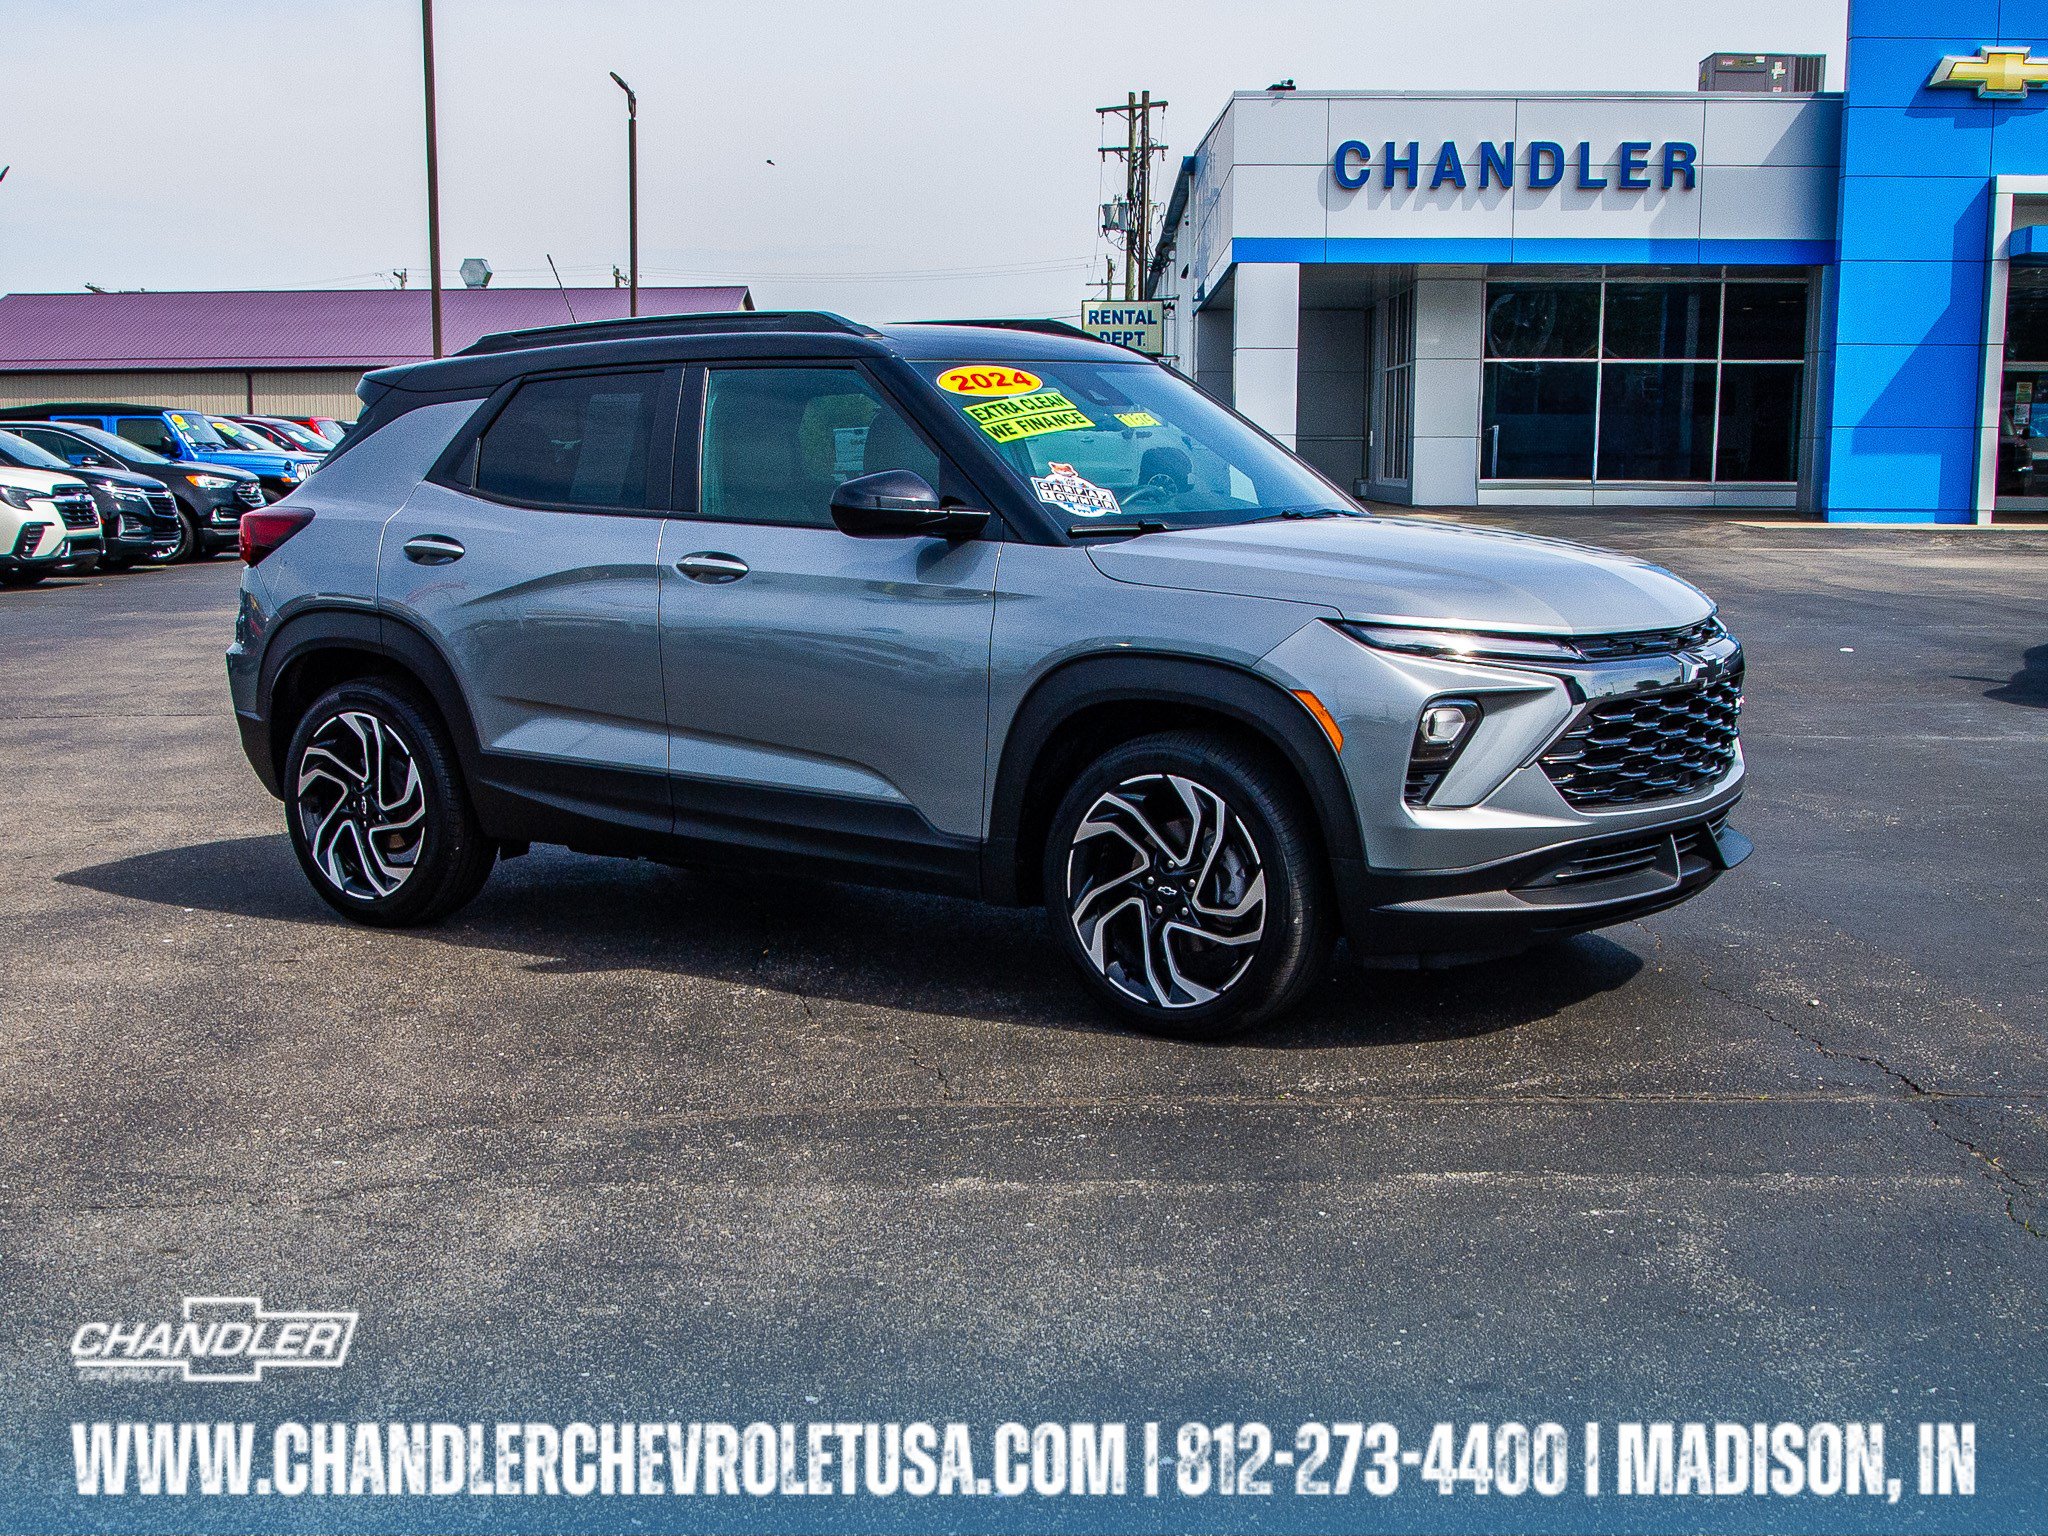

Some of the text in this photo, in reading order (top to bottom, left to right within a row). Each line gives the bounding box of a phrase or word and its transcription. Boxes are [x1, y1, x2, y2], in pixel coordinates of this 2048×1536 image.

[1334, 140, 1698, 189] CHANDLER
[1088, 310, 1157, 325] RENTAL
[1100, 331, 1146, 346] DEPT.
[950, 372, 1032, 391] 2024
[971, 394, 1068, 421] EXTRA CLEAN
[986, 412, 1087, 439] WE FINANCE
